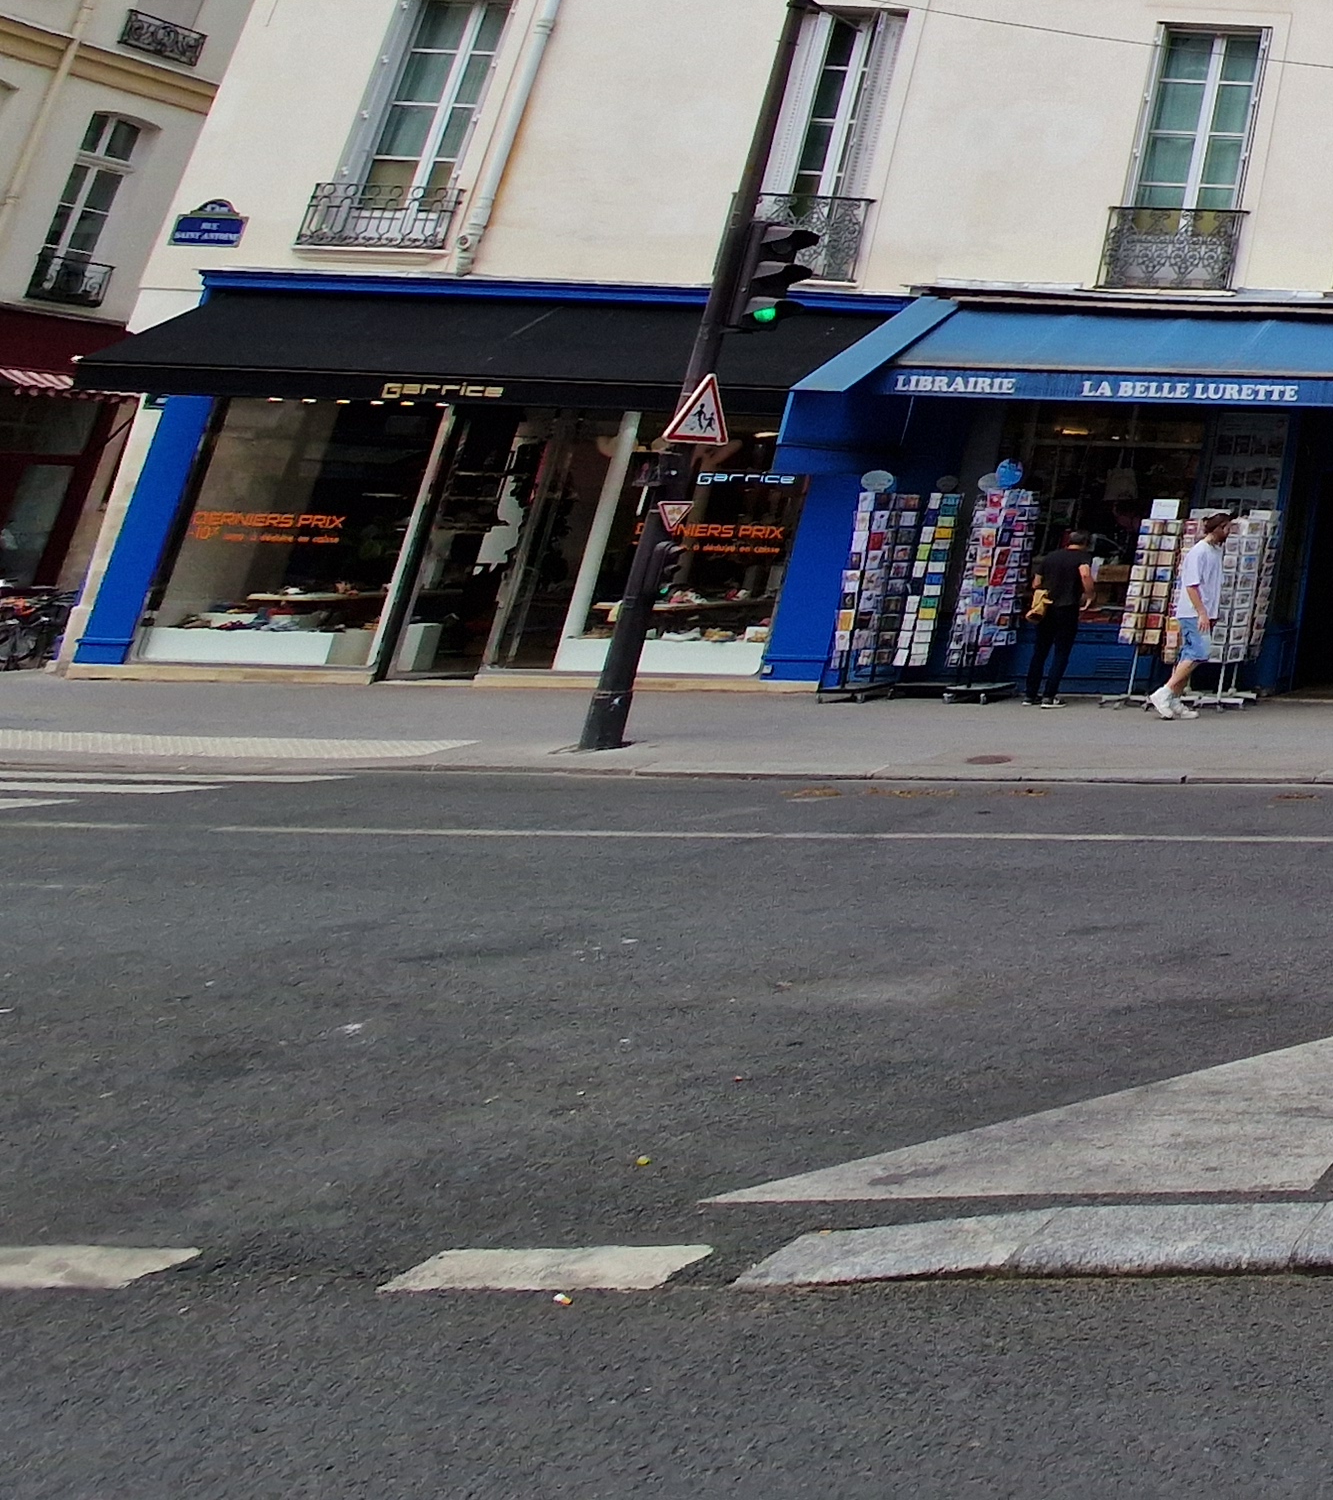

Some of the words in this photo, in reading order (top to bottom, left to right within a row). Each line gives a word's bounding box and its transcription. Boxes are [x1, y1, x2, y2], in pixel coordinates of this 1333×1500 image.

[894, 375, 1016, 394] LIBRAIRIE
[1081, 380, 1113, 397] LA
[1117, 381, 1189, 399] BELLE
[1194, 383, 1299, 402] LURETTE
[193, 510, 294, 528] DERNIERS
[298, 514, 348, 529] PRIX
[738, 525, 786, 539] PRIX
